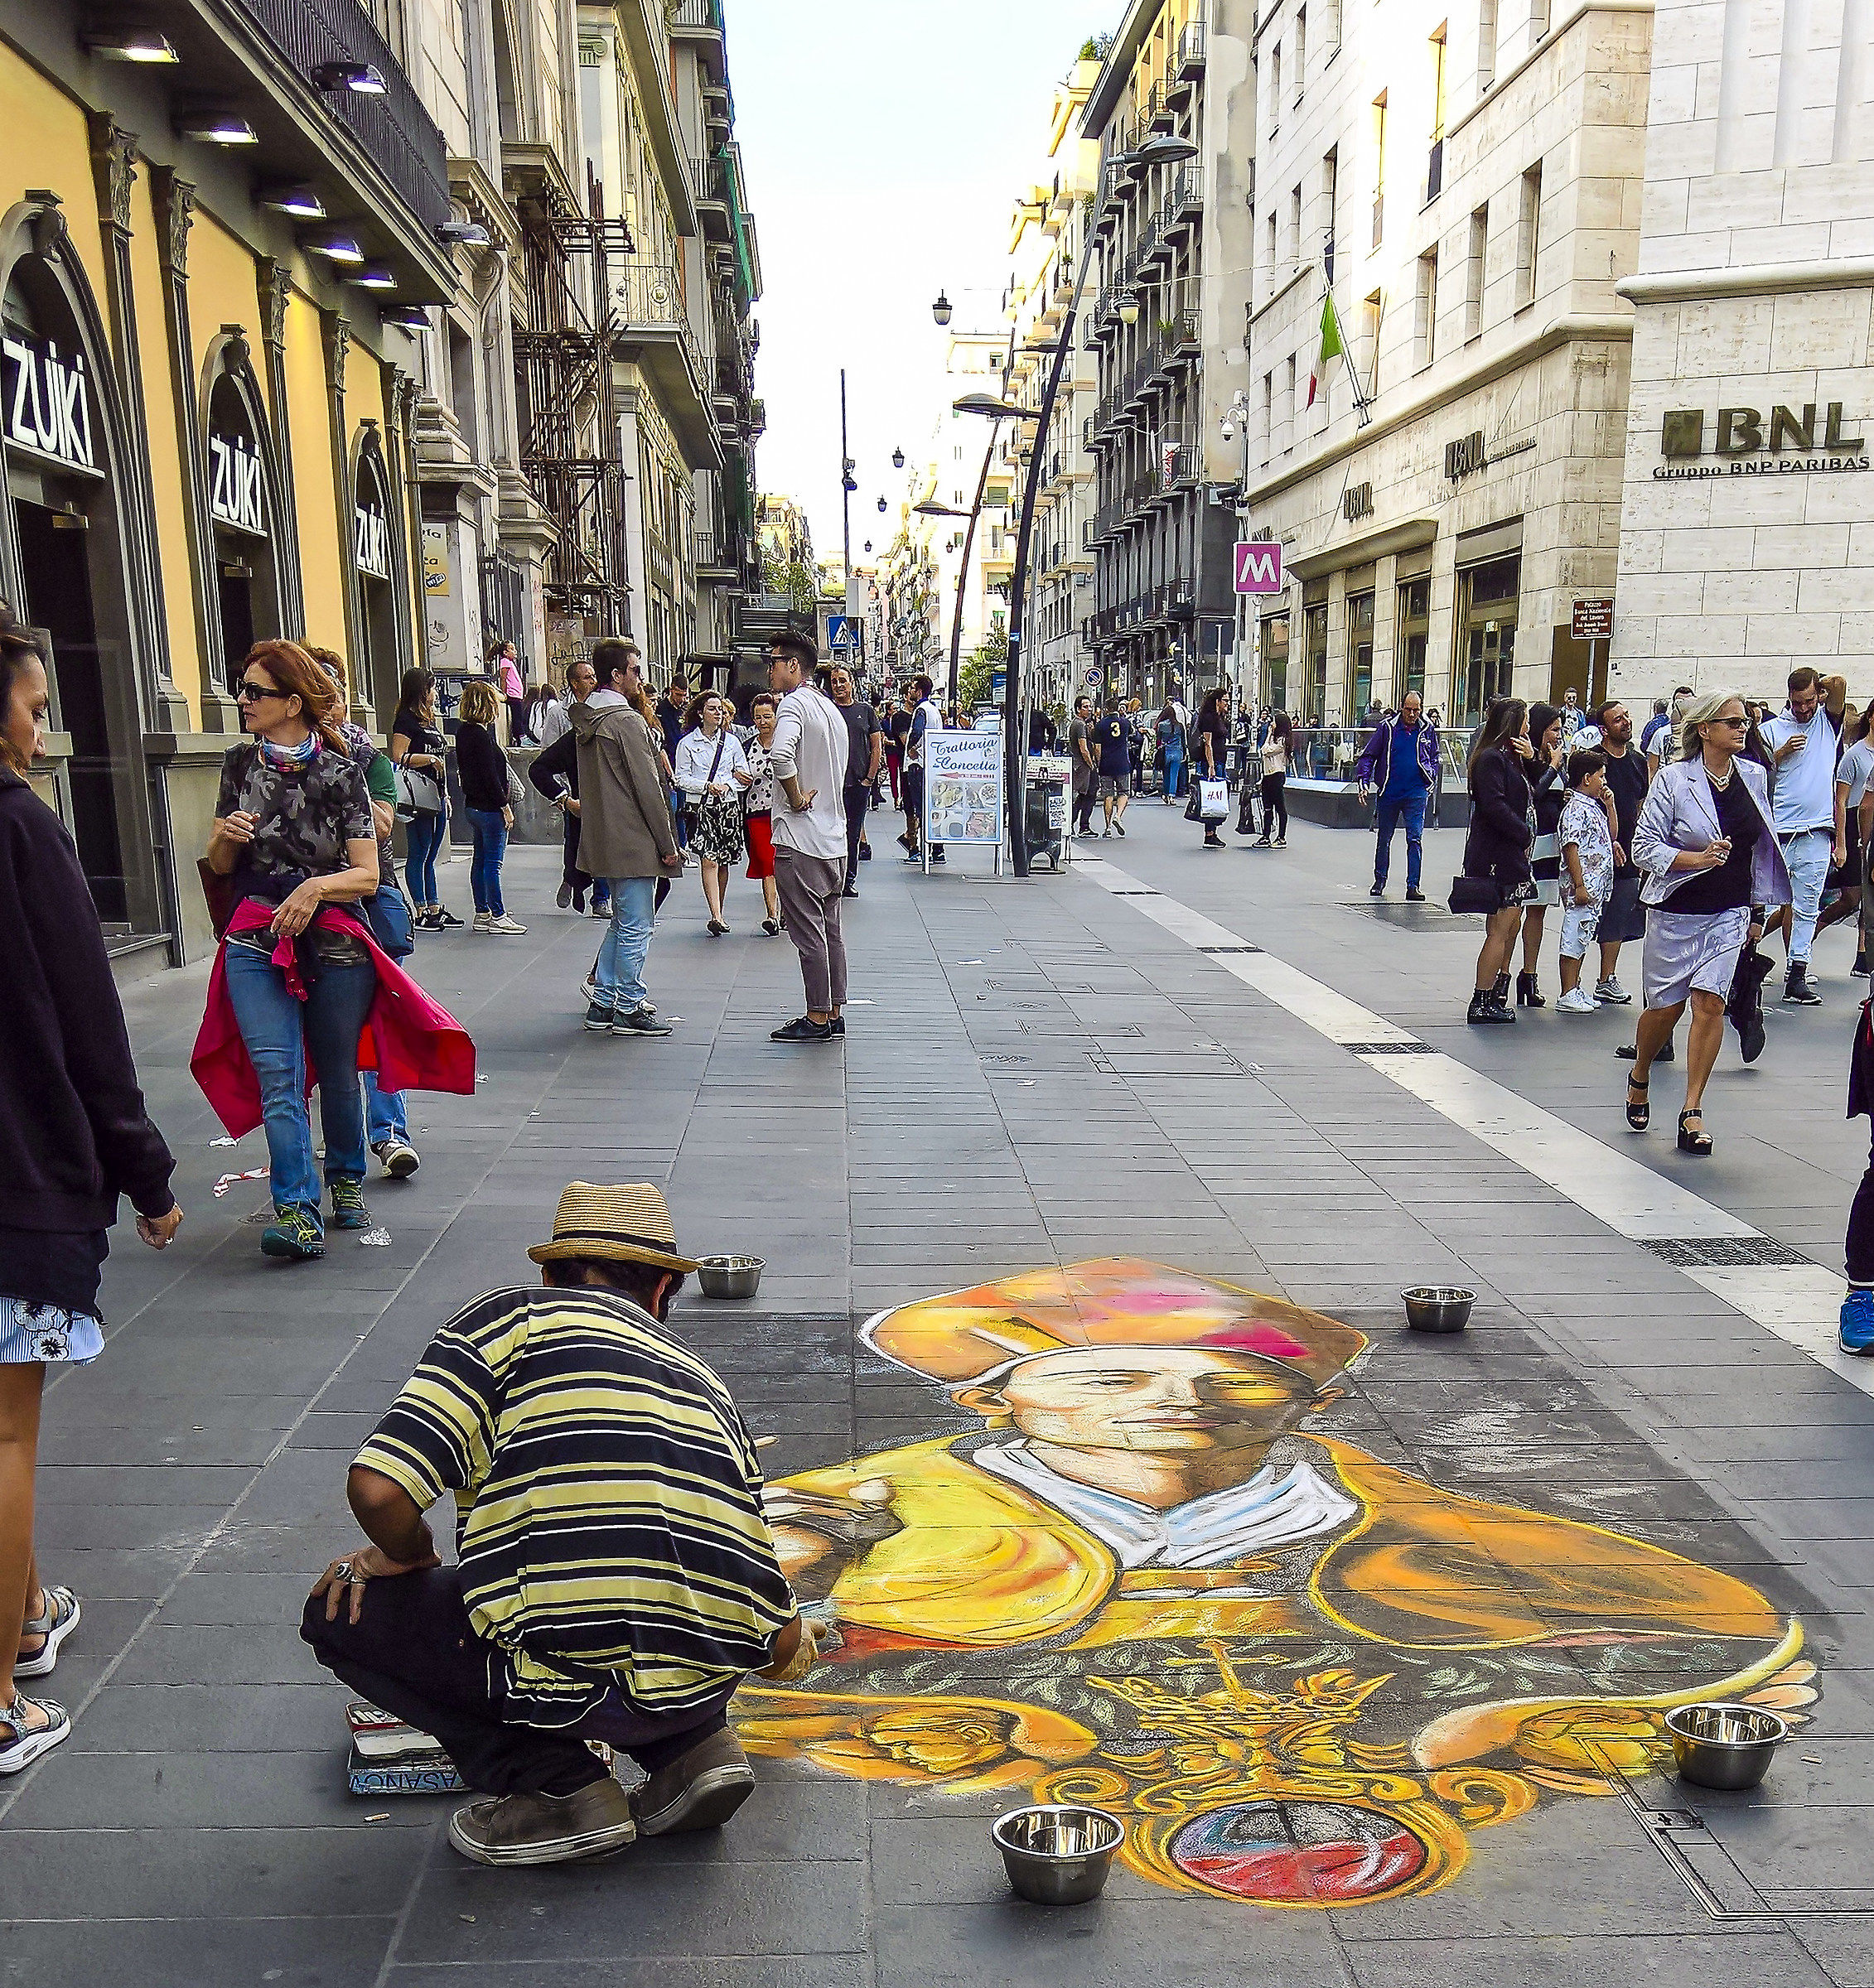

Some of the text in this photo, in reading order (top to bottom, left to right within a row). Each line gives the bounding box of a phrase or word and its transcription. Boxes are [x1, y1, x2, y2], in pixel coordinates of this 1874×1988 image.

[1716, 402, 1865, 452] BNL
[1652, 456, 1870, 480] Gruppo BNP PARIBAS
[1239, 552, 1278, 583] M
[1110, 721, 1121, 737] 3
[930, 737, 998, 755] Trattoria
[935, 756, 998, 771] Concetta
